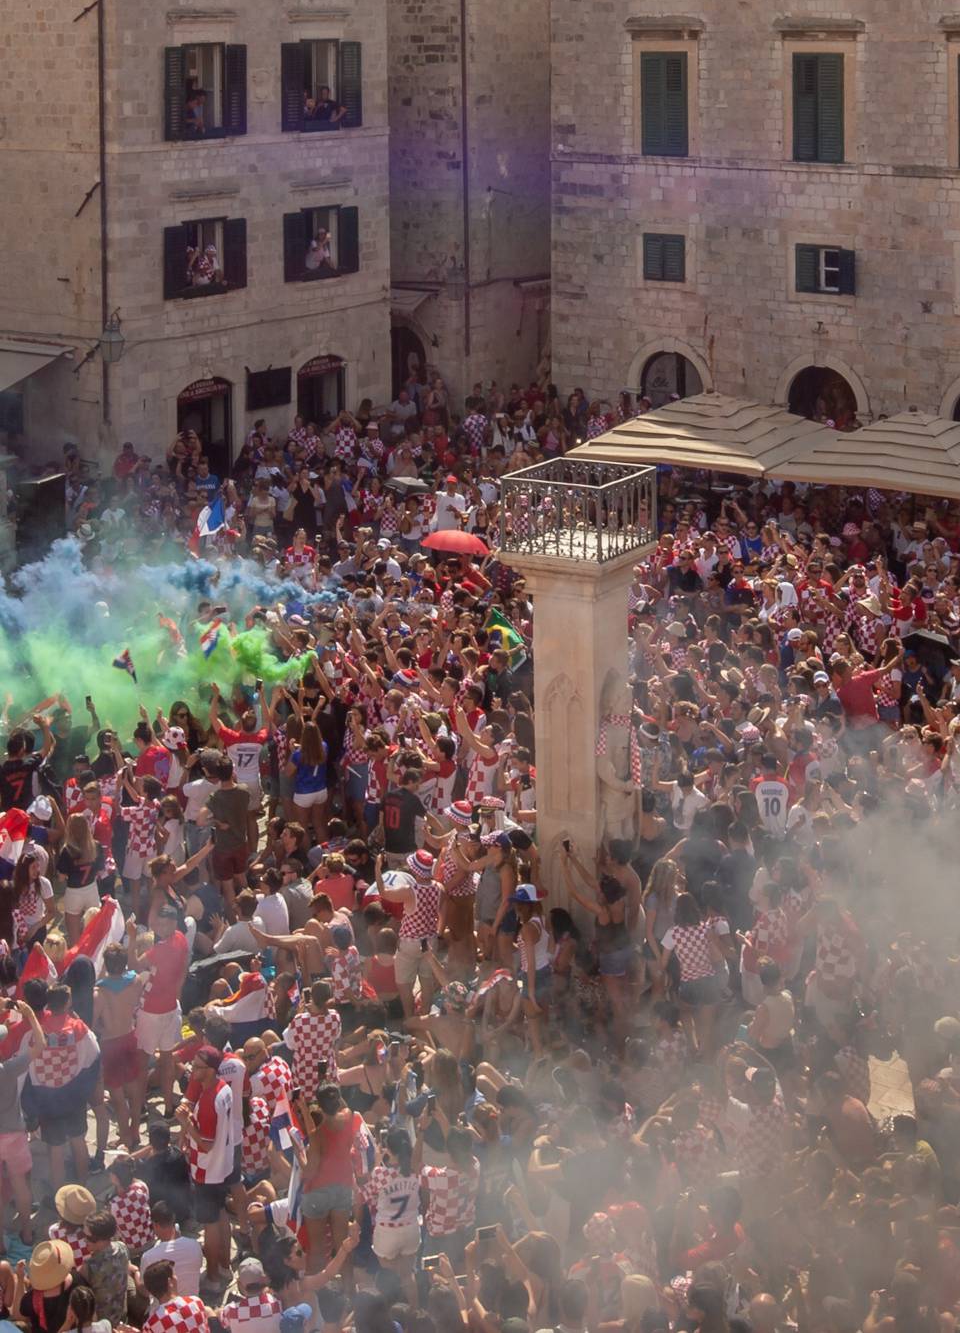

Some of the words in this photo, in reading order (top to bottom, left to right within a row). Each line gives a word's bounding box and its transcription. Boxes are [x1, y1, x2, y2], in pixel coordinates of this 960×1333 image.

[238, 753, 255, 768] 17
[384, 806, 400, 829] 10
[763, 797, 781, 818] 10
[79, 865, 91, 885] 7
[390, 1195, 410, 1221] 7
